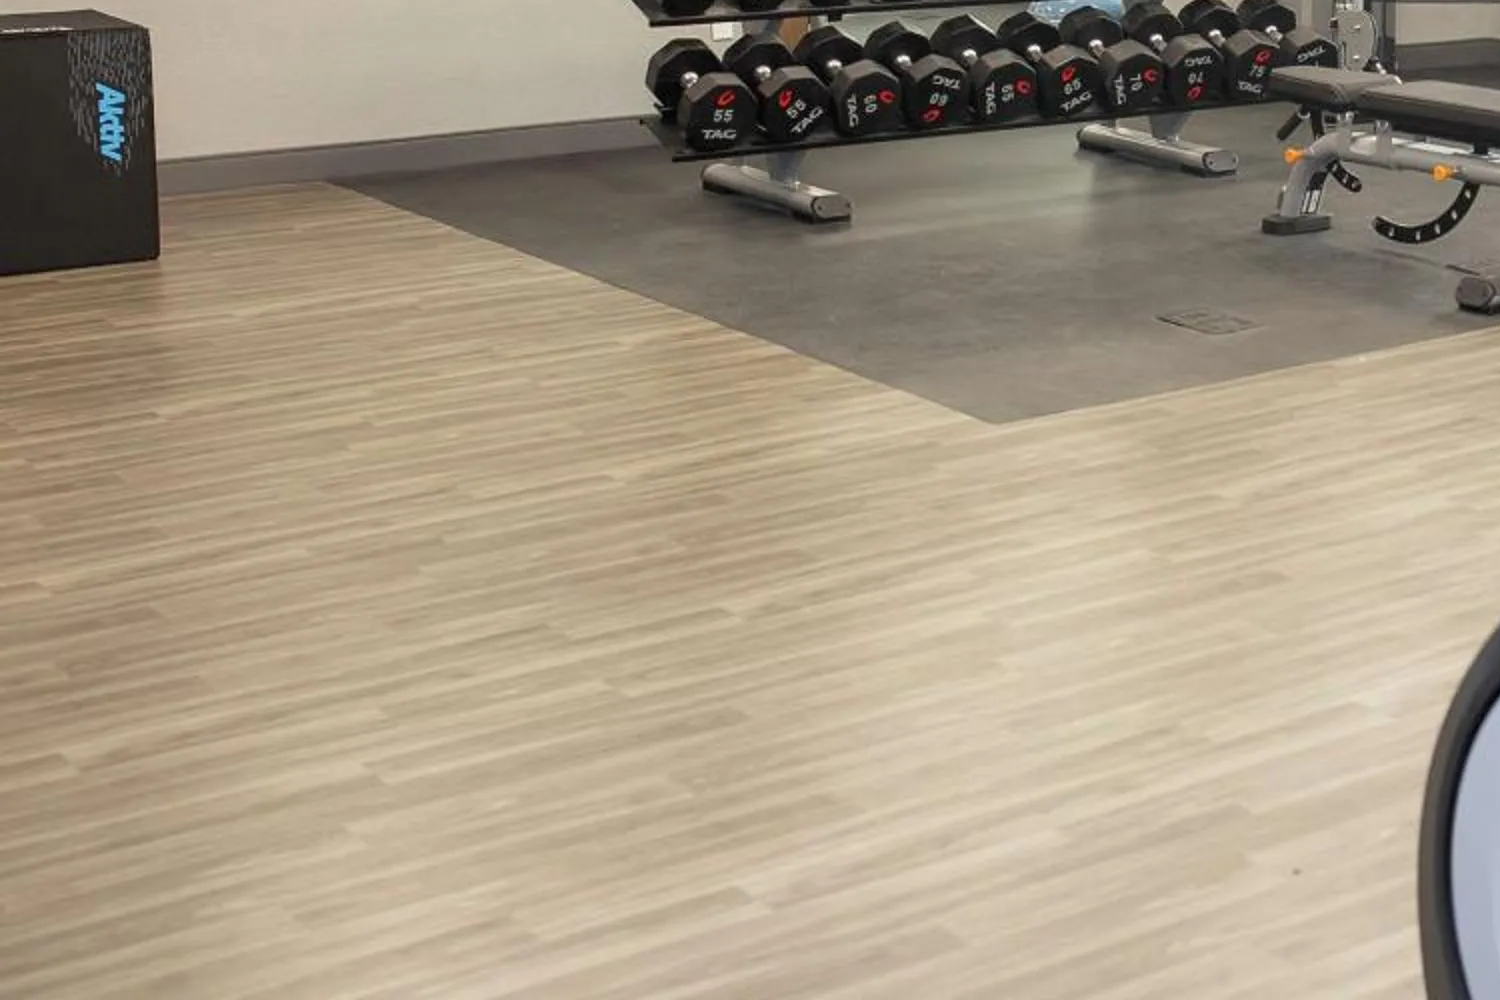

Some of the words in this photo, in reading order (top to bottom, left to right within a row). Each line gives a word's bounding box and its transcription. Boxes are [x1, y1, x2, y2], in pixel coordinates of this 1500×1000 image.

[1184, 56, 1213, 67] TAG
[1297, 45, 1327, 63] TAG
[932, 75, 960, 89] TAG
[1114, 73, 1127, 105] TAG
[1236, 80, 1263, 93] TAG
[985, 81, 997, 115] TAG
[1060, 91, 1093, 112] TAG
[713, 109, 734, 123] 55
[790, 105, 823, 133] TAG
[847, 93, 859, 128] TAG
[701, 129, 737, 139] TAG
